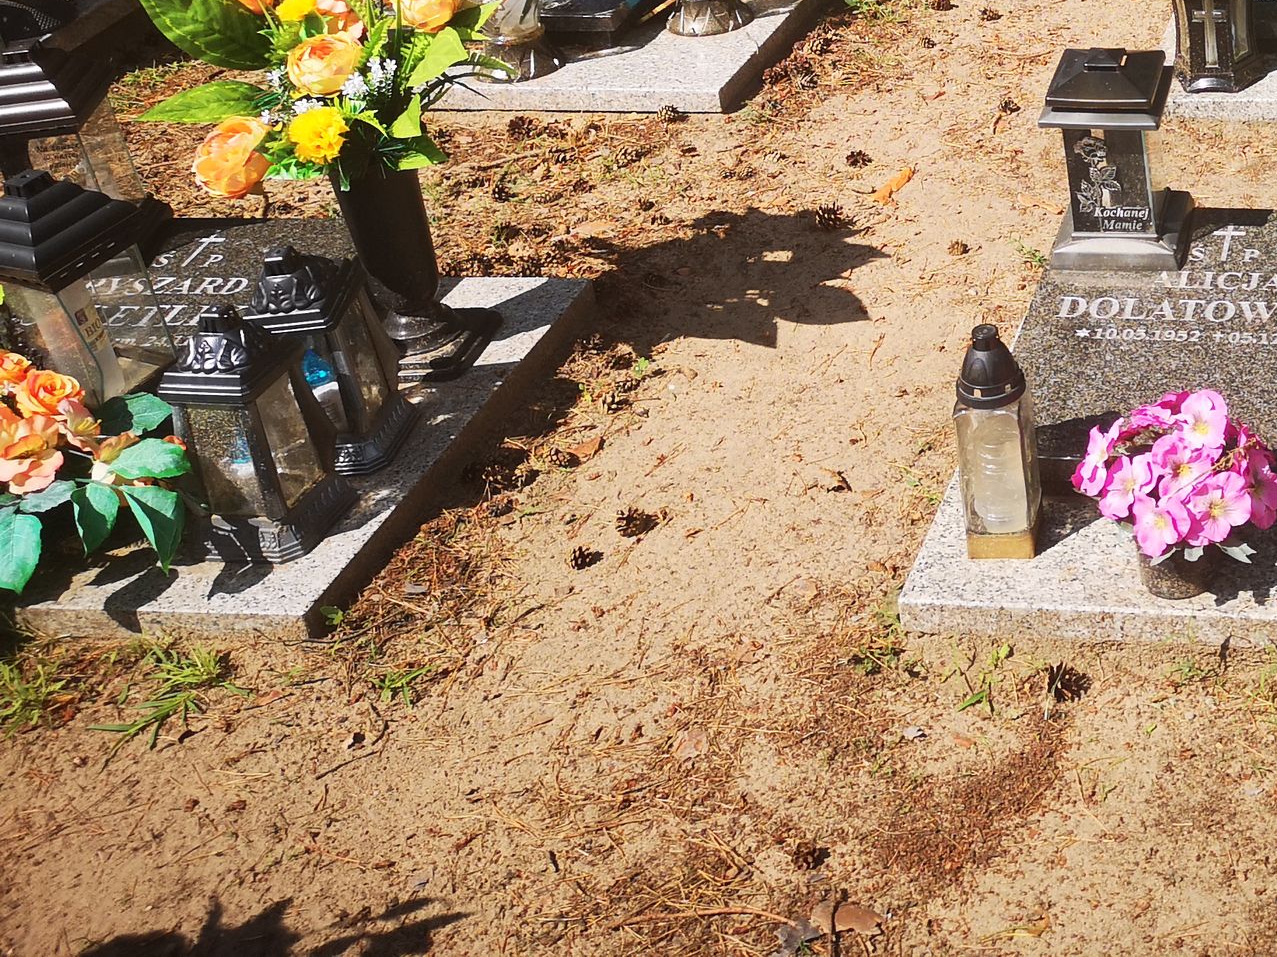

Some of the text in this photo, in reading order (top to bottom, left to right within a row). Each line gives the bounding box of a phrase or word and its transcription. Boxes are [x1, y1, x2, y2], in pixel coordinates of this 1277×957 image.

[1094, 207, 1150, 221] Kochanej
[1103, 219, 1143, 230] Mamie
[1189, 247, 1260, 263] S P
